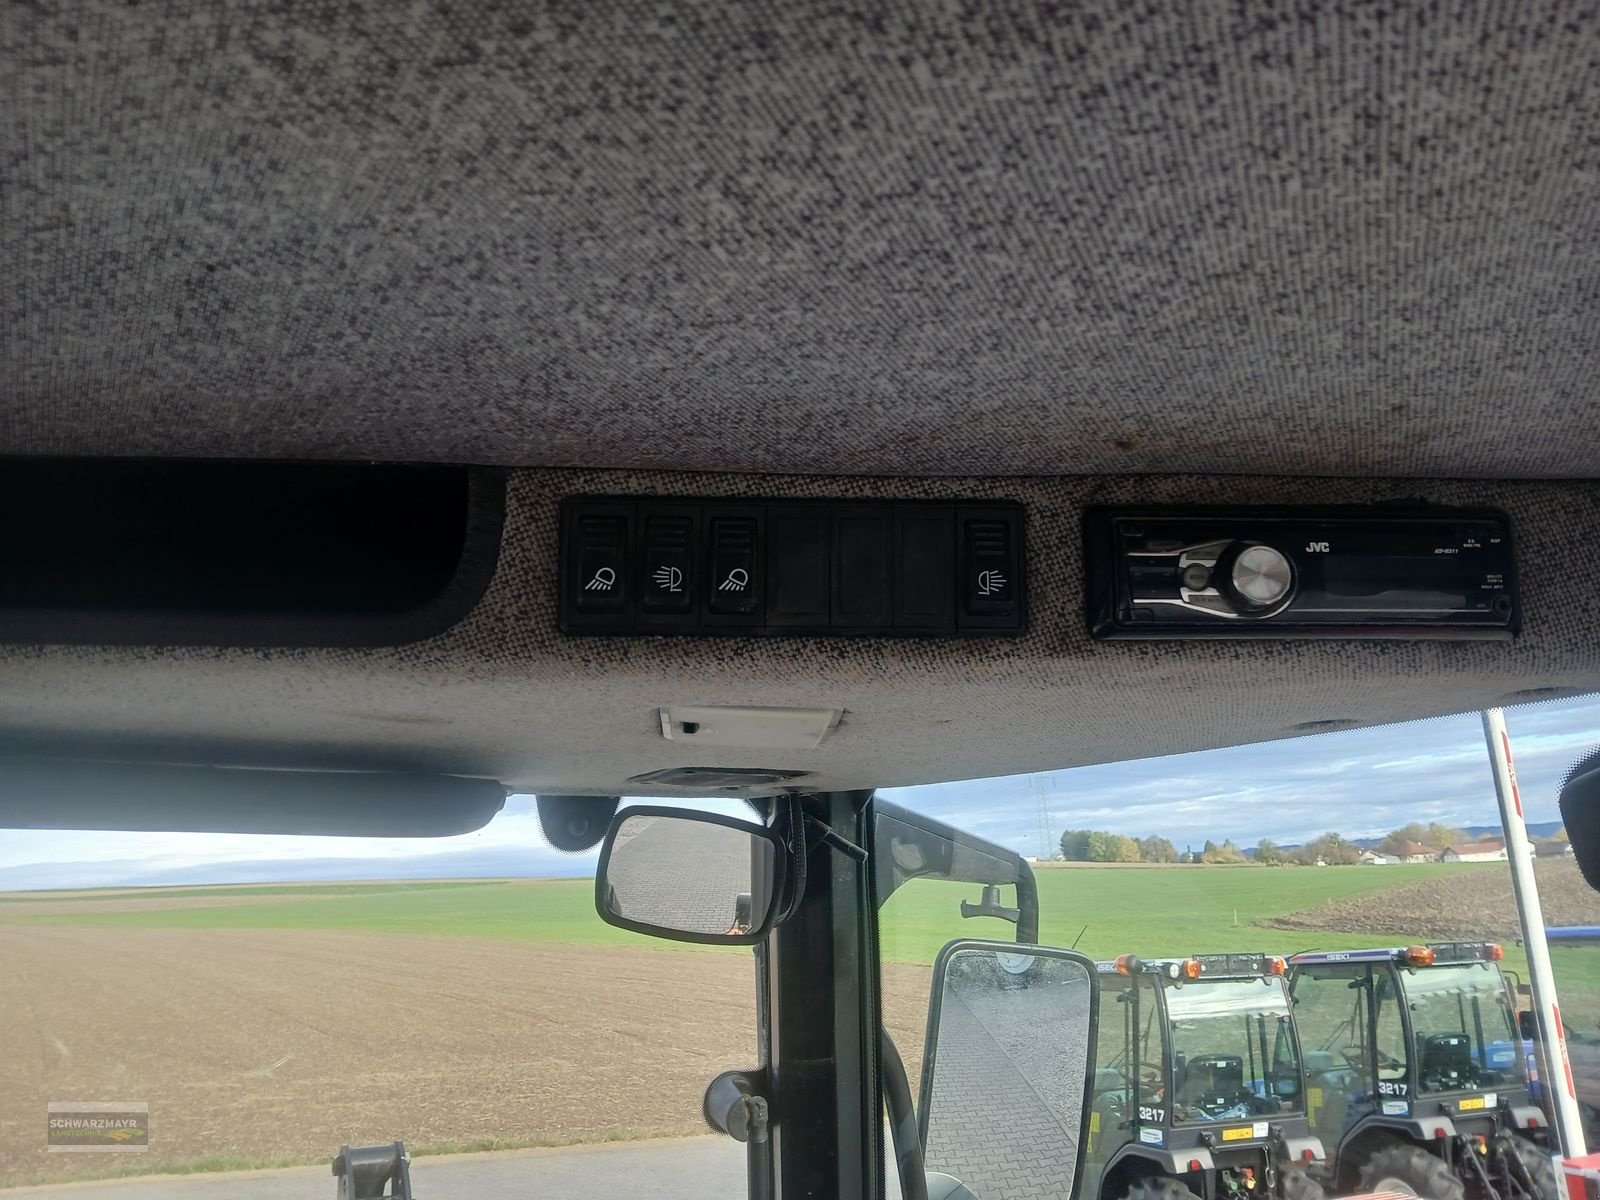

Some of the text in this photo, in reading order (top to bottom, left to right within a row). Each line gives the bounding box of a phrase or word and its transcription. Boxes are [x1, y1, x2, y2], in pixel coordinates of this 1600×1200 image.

[1306, 542, 1330, 552] JVC
[1097, 963, 1117, 971] ISEK
[1378, 1082, 1408, 1096] 3217
[1139, 1106, 1165, 1122] 3217
